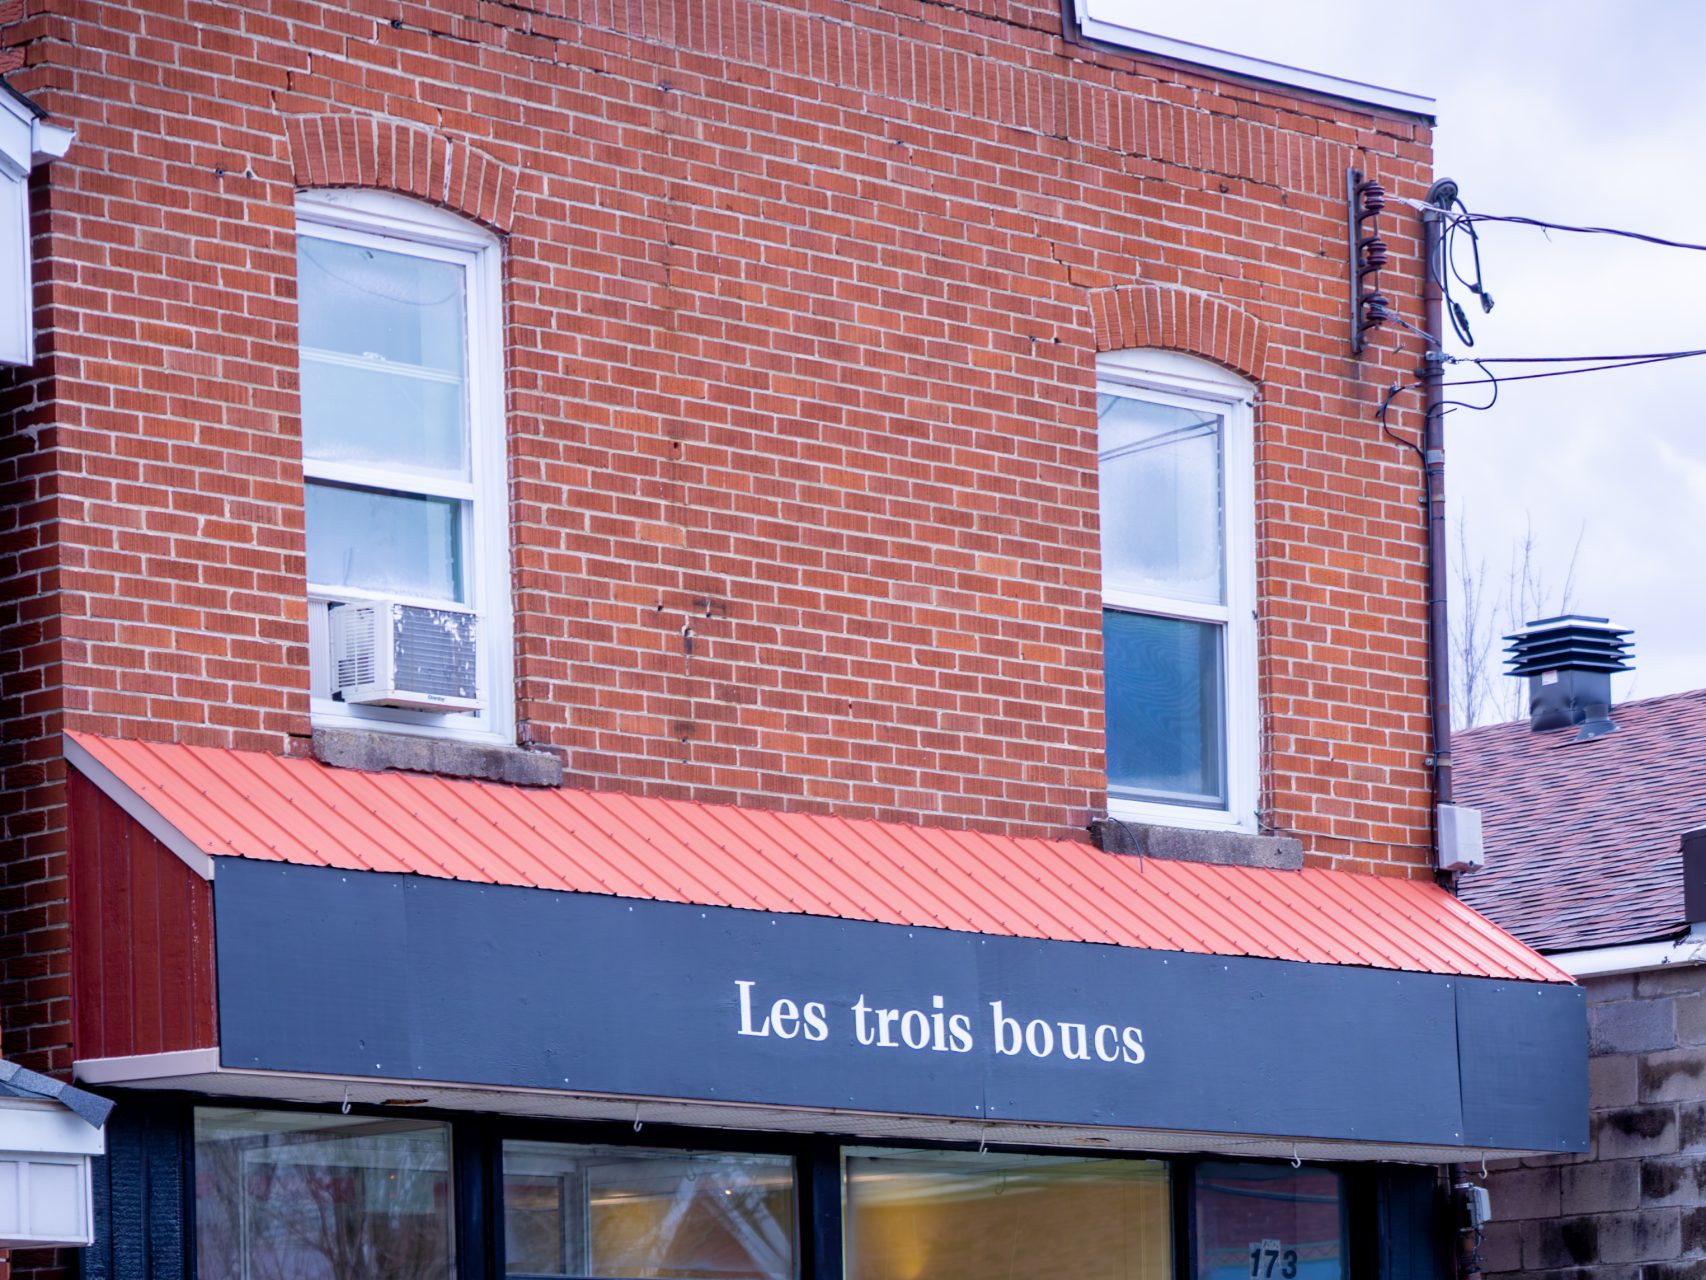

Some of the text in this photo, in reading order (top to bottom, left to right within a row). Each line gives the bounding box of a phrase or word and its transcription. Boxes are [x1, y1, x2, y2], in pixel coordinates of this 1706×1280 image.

[734, 980, 1146, 1064] Les trois boucs
[1251, 1248, 1298, 1280] 173
